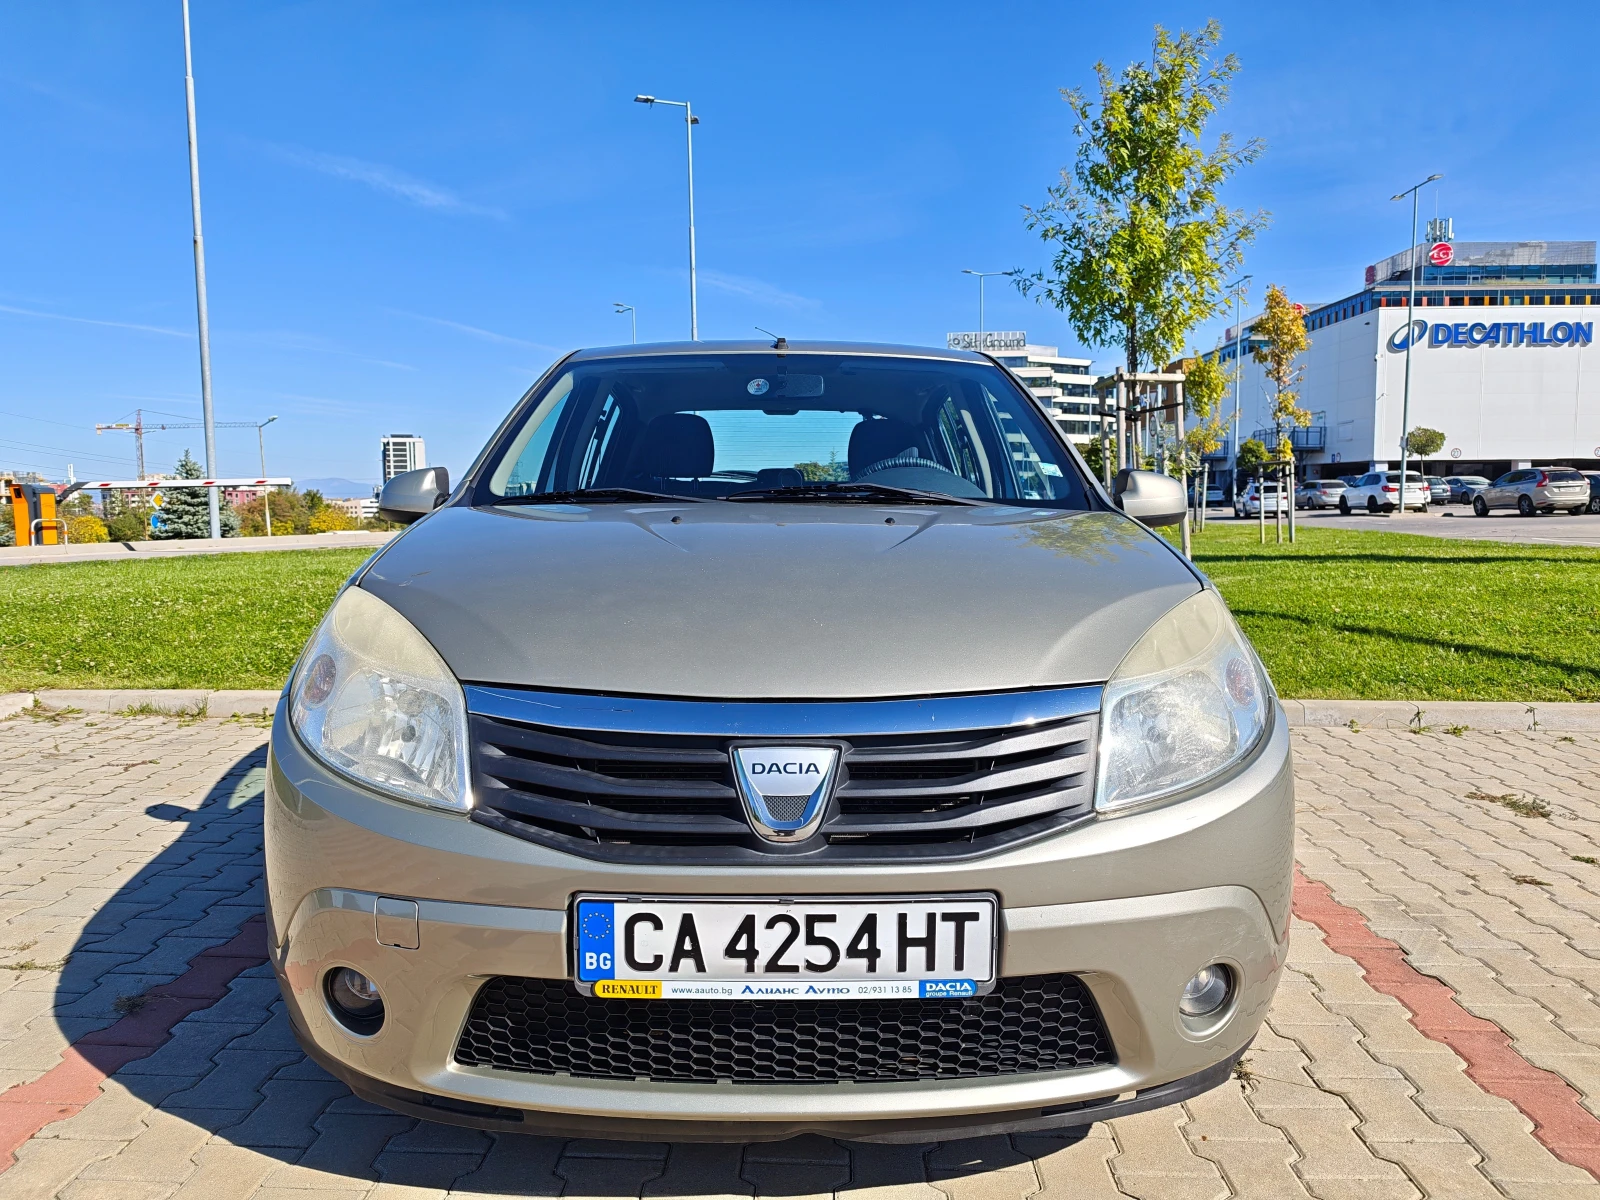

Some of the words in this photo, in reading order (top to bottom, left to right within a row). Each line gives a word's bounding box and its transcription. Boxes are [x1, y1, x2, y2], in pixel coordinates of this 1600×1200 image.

[1433, 321, 1594, 345] DECATHLON
[751, 762, 820, 775] DACIA
[624, 912, 707, 973] CA
[724, 912, 881, 973] 4254
[897, 912, 980, 972] HT
[585, 952, 612, 970] BG
[601, 984, 658, 995] RENAULT
[671, 986, 733, 996] www.aauto.bg
[857, 986, 887, 994] 02/931
[890, 985, 900, 993] 13
[901, 985, 913, 993] 85
[925, 982, 972, 991] DACIA
